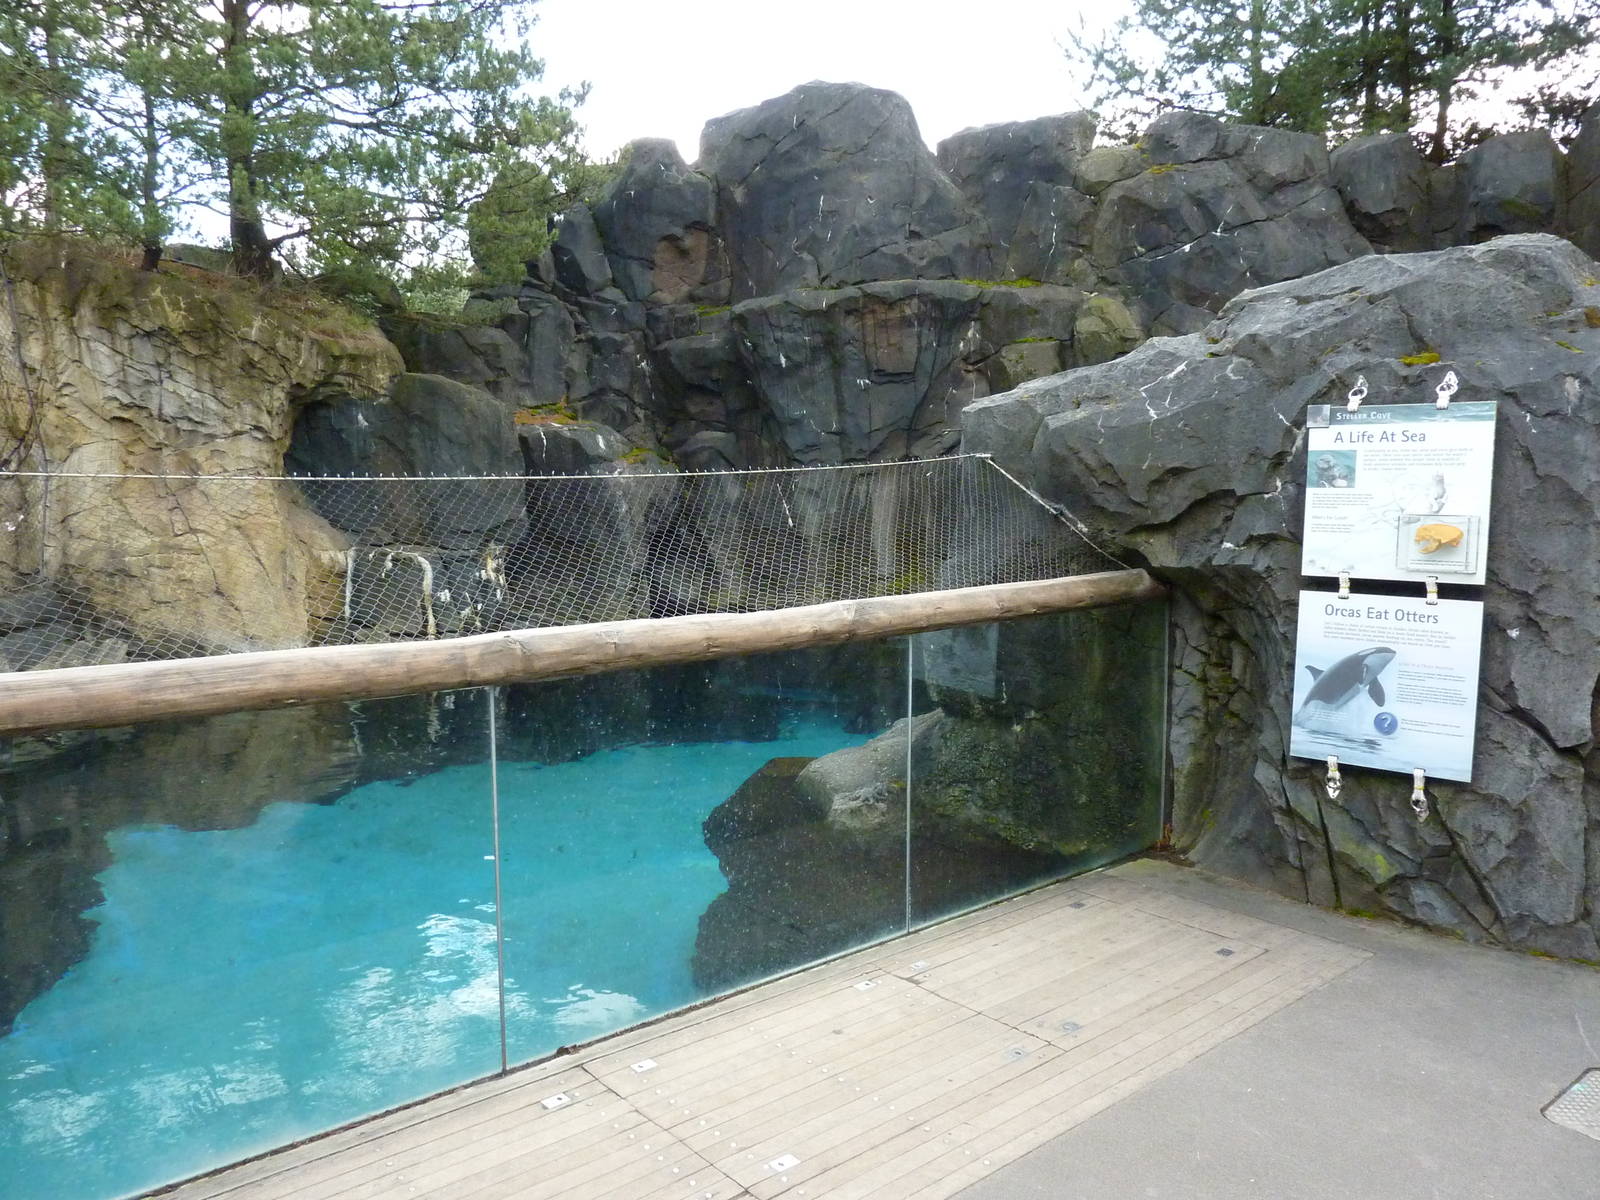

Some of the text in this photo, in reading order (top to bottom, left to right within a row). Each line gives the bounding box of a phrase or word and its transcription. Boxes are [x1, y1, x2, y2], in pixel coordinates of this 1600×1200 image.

[1334, 429, 1426, 443] A Life At Sea
[1324, 604, 1439, 624] Orcas Eat Otters
